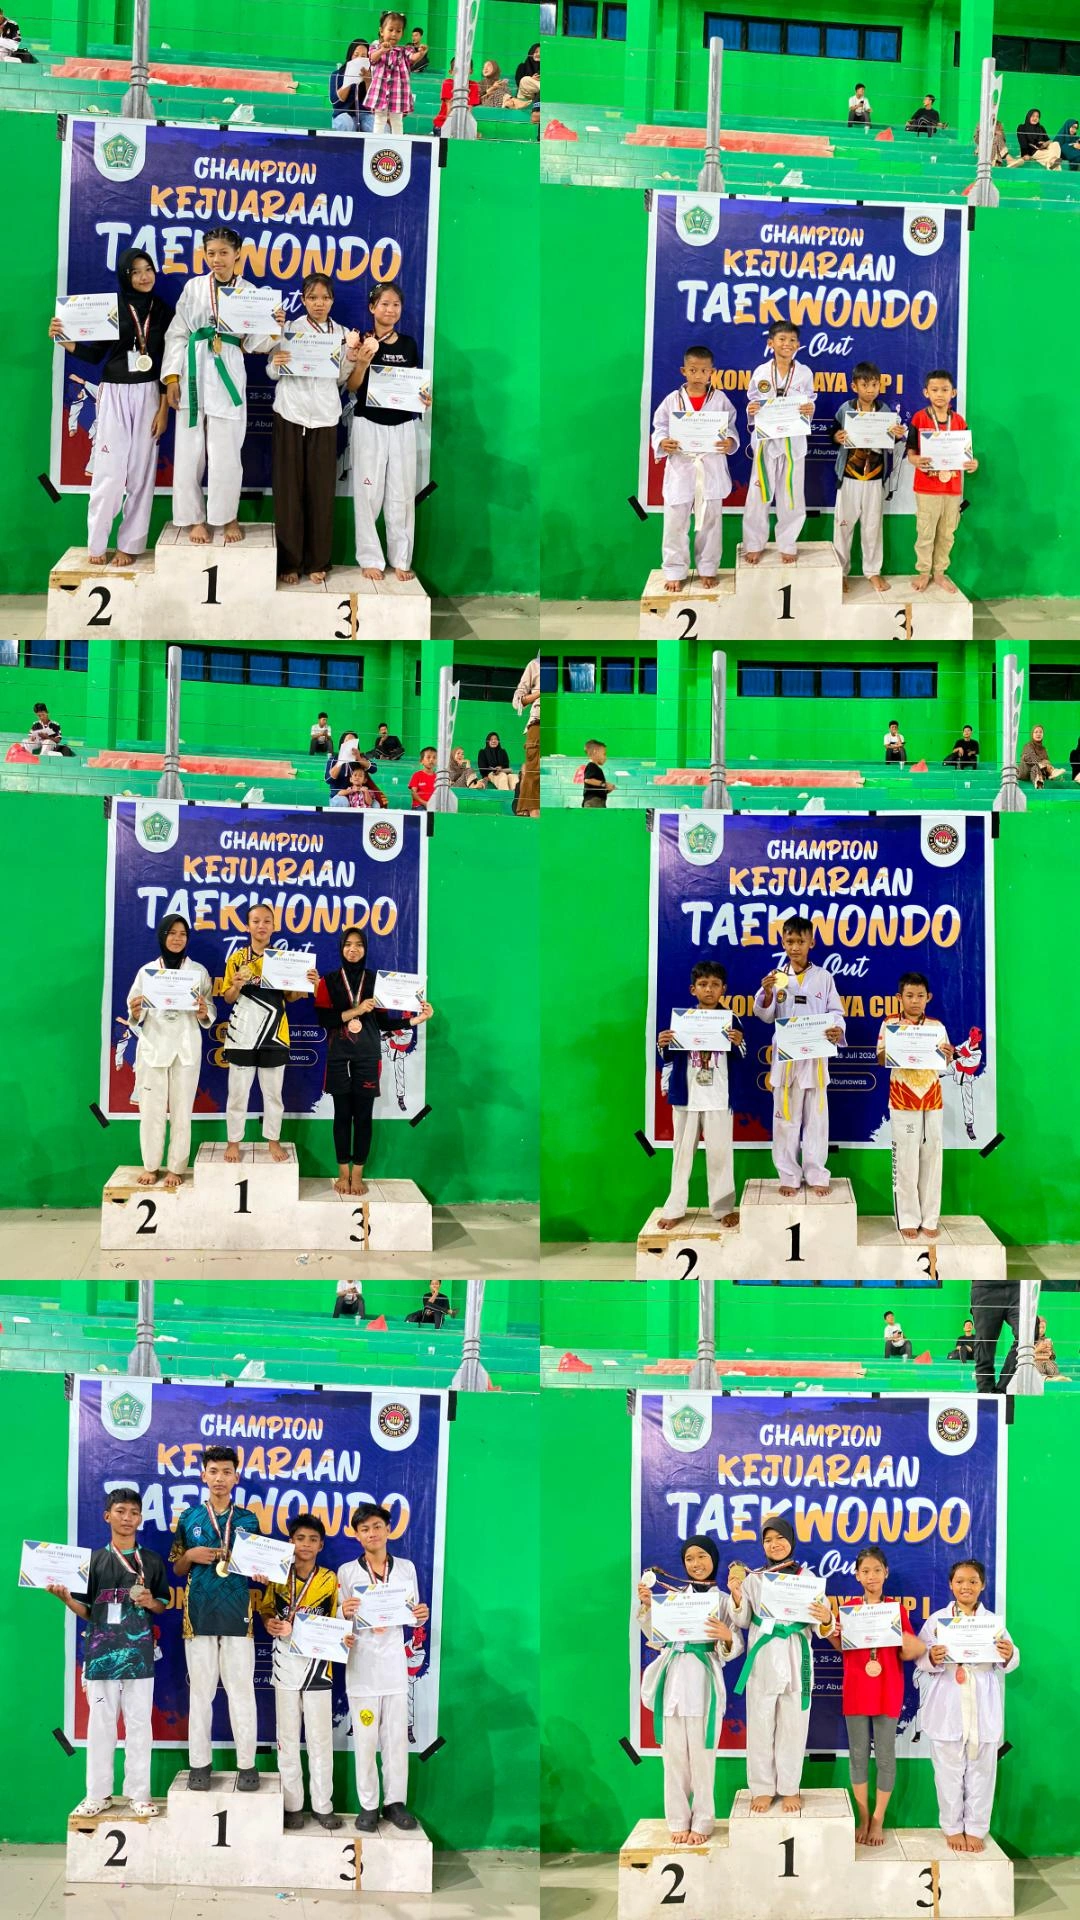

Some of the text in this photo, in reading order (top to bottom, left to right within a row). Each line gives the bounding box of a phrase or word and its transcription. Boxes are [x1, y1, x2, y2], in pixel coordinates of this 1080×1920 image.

[194, 156, 317, 185] CHAMPION
[150, 184, 354, 227] KEJUARAAN
[760, 224, 864, 247] CHAMPION
[95, 221, 402, 283] TAEWONDO
[723, 248, 896, 282] KEJUARAAN
[677, 280, 938, 331] TAEKWONDO
[808, 332, 854, 357] Out
[249, 392, 272, 400] 25-26
[711, 369, 752, 391] KON
[813, 371, 848, 393] AYA
[86, 565, 360, 639] 2 1 3
[676, 608, 698, 640] 2
[777, 584, 796, 620] 1
[219, 830, 324, 853] CHAMPION
[767, 839, 878, 861] CHAMPION
[183, 855, 356, 888] KEJUARAAN
[729, 866, 913, 897] KEJUARAAN
[823, 953, 870, 978] Out
[135, 1178, 372, 1242] 2 1 3
[675, 1248, 699, 1280] 2
[785, 1222, 806, 1262] 1
[200, 1413, 324, 1441] CHAMPION
[759, 1423, 882, 1448] CHAMPION
[717, 1453, 920, 1488] KEJUARAAN
[818, 1549, 857, 1578] Ou
[819, 1655, 842, 1663] 25-26
[104, 1809, 363, 1881] 2 1 3
[660, 1836, 942, 1908] 2 1 3
